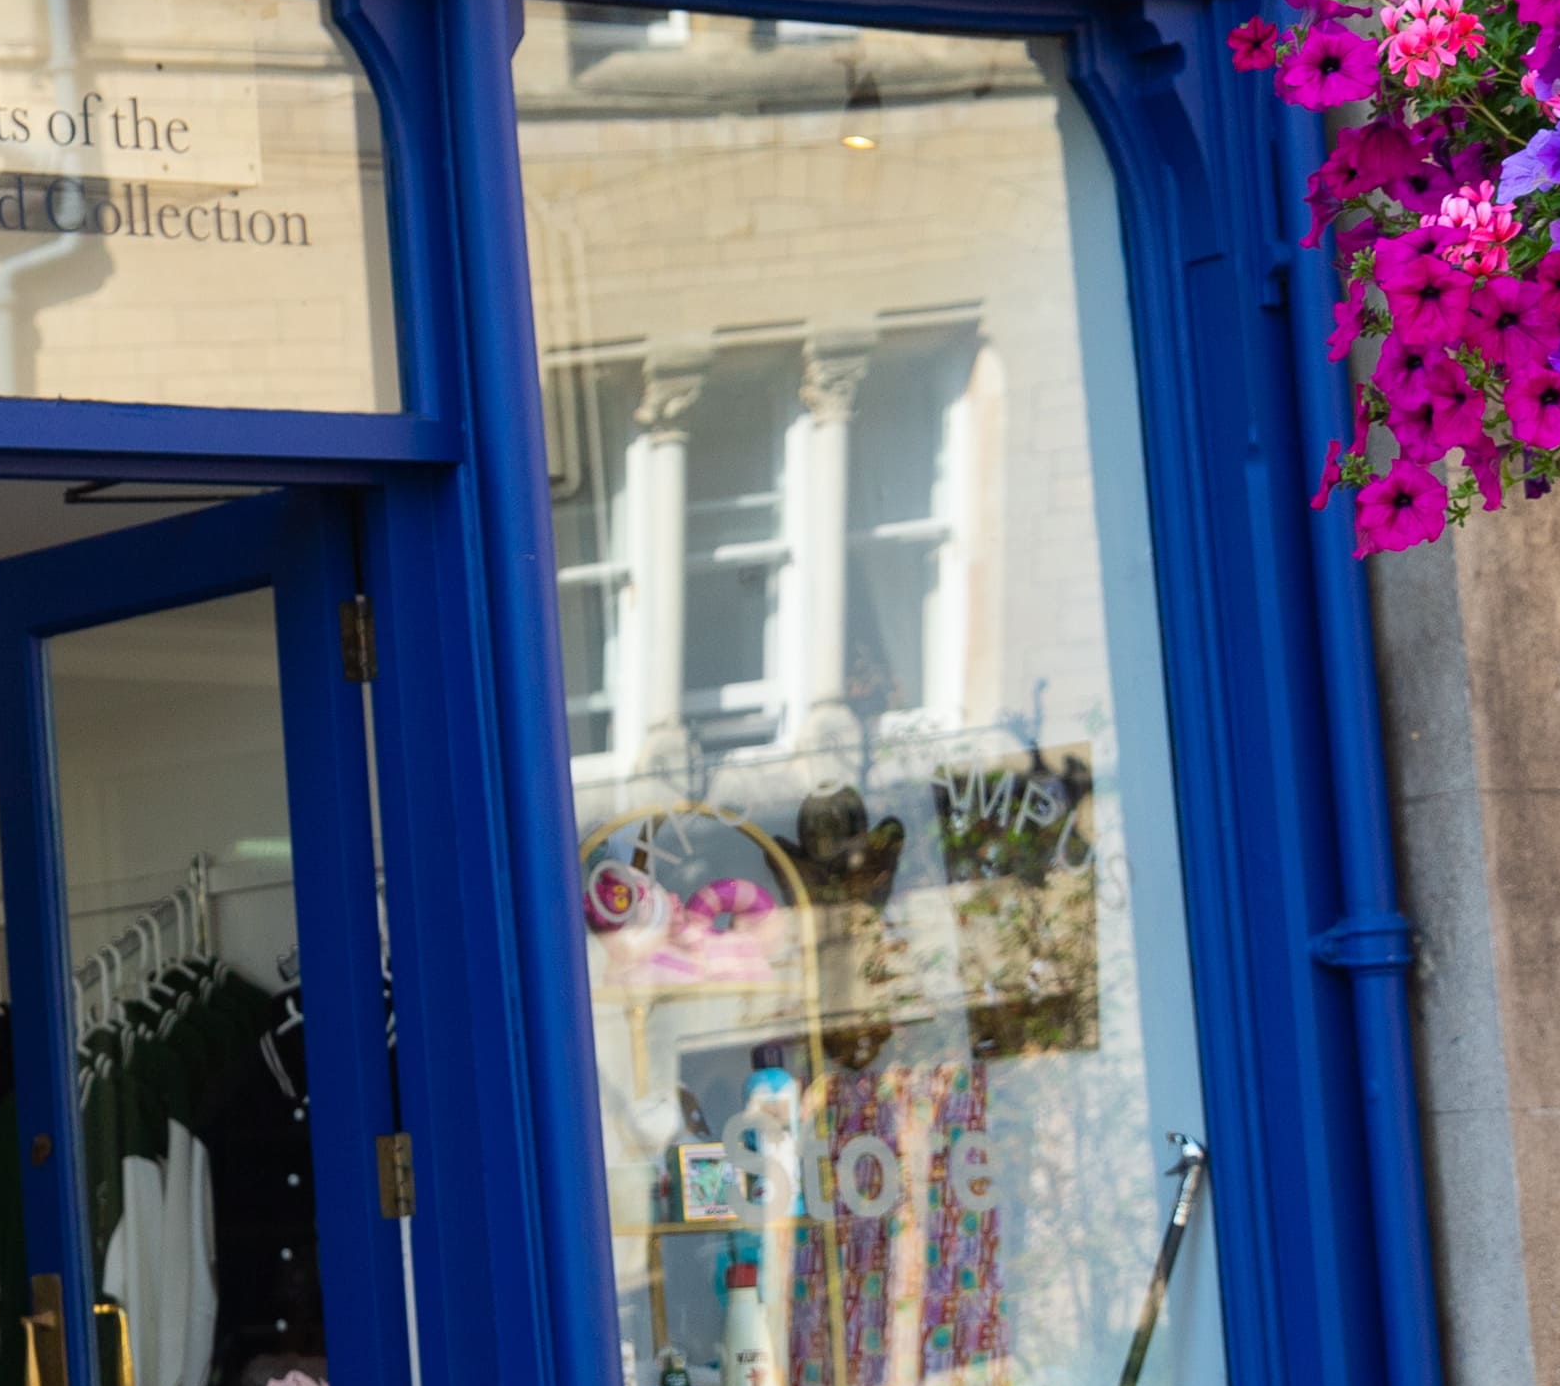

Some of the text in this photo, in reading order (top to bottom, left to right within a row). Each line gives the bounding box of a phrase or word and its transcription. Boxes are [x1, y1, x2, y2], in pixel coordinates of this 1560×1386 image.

[46, 91, 103, 148] of
[109, 96, 190, 155] the
[45, 177, 311, 246] Collection
